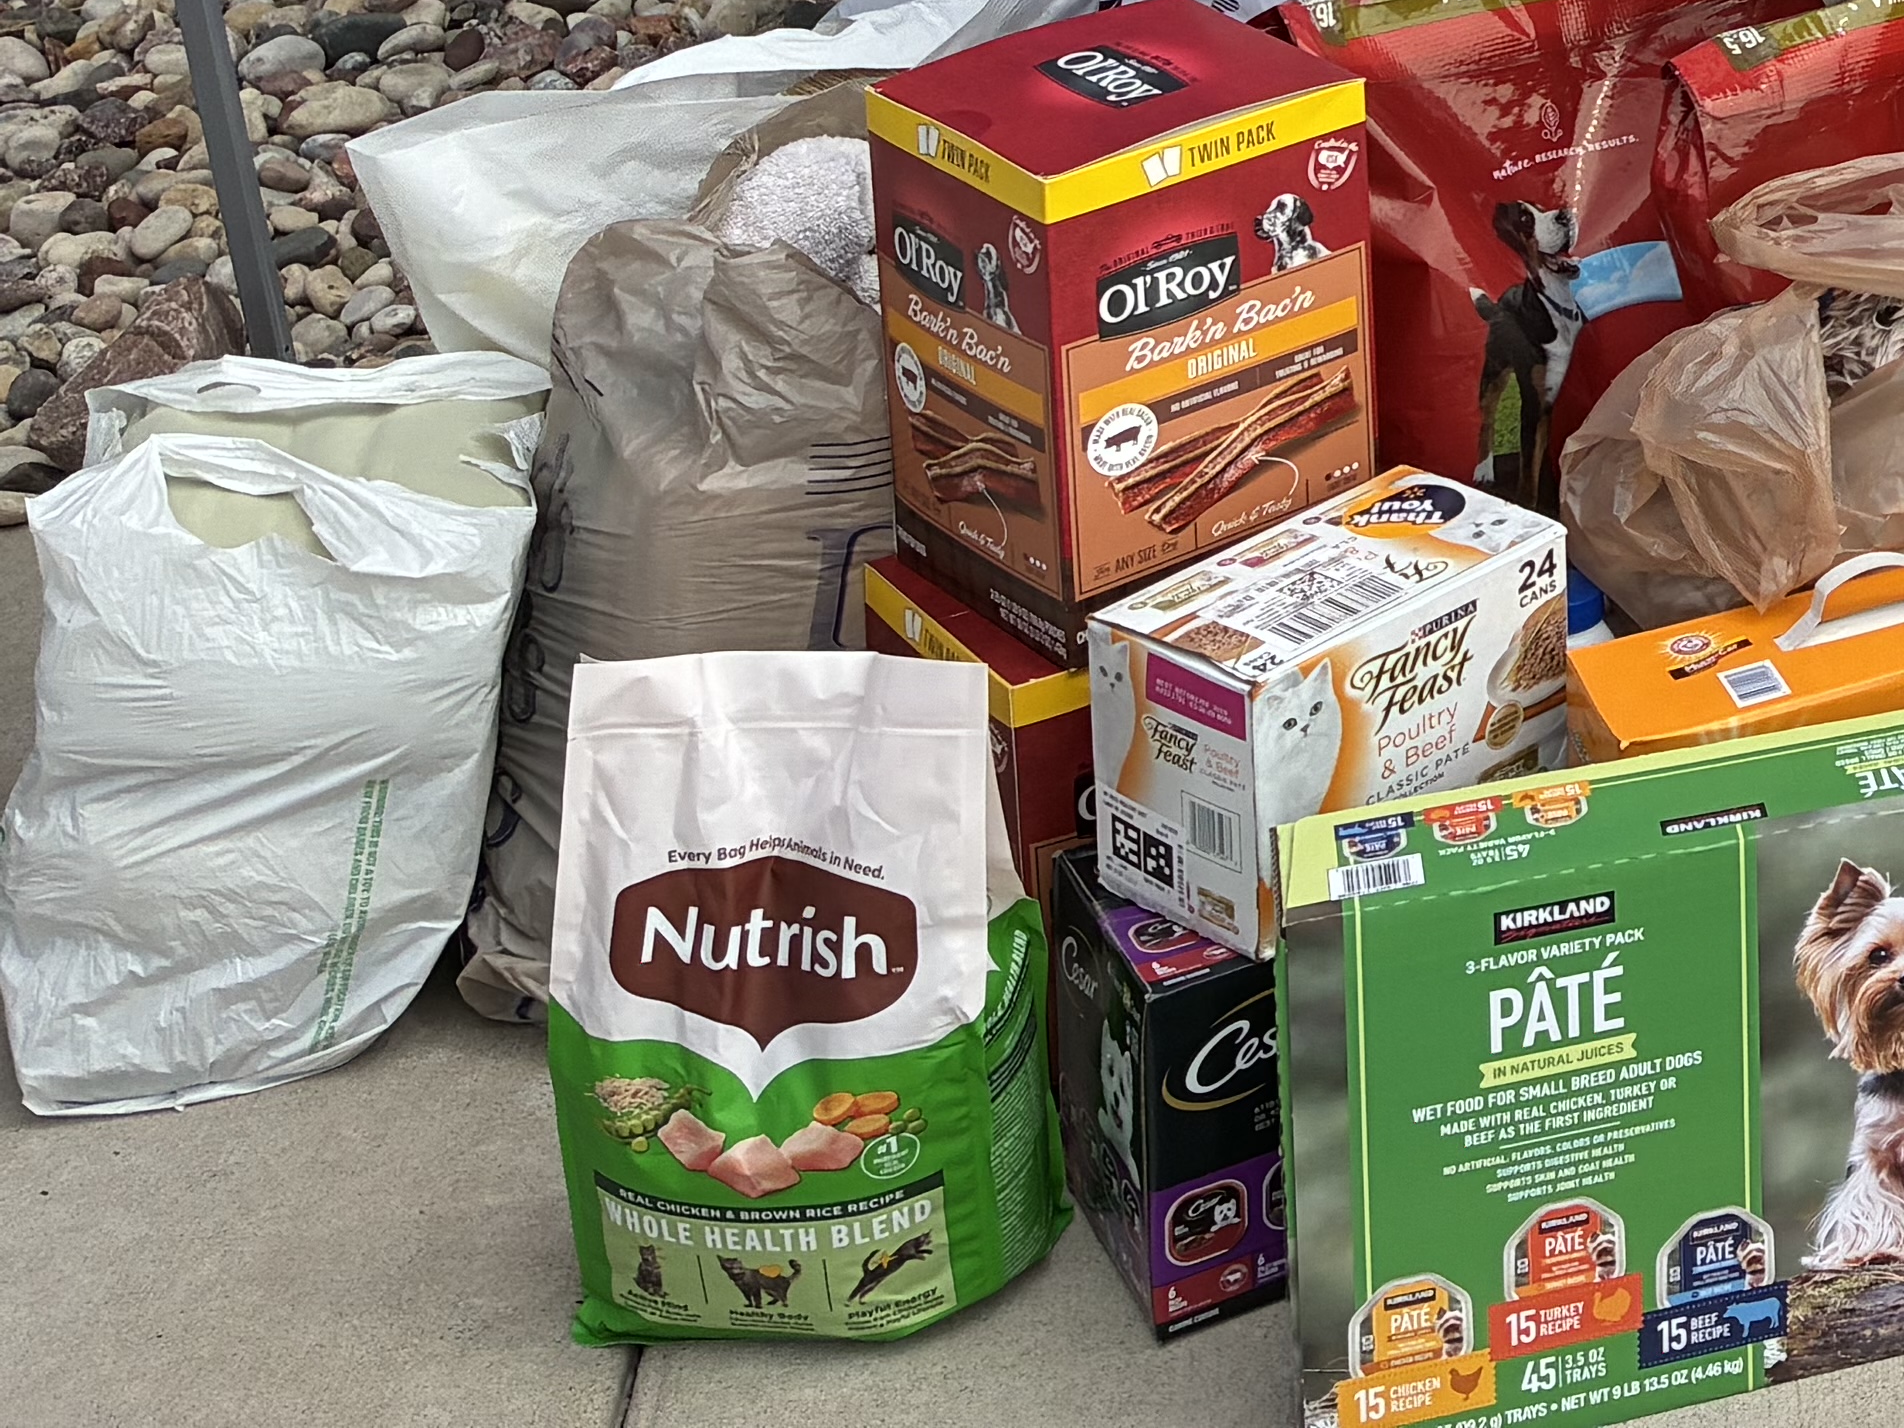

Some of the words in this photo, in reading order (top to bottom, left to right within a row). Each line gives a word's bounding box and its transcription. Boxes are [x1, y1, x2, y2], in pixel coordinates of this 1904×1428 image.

[1188, 134, 1230, 165] TWIN
[1236, 121, 1276, 152] PACK
[1099, 253, 1237, 325] Ol'Roy
[1187, 338, 1257, 379] ORIGINAL
[1518, 548, 1557, 594] 24
[1519, 580, 1557, 608] CANS
[1424, 602, 1475, 635] PURINA
[1350, 615, 1476, 703] Fancy
[1371, 650, 1474, 736] Feast
[1378, 702, 1458, 757] Poultry
[1381, 761, 1396, 780] &
[1405, 724, 1456, 769] Beef
[668, 850, 712, 864] Every
[718, 847, 746, 861] Bag
[829, 852, 841, 866] in
[843, 857, 885, 880] Need.
[1501, 896, 1611, 930] KIRKLAND
[640, 906, 888, 978] Nutrish
[1465, 949, 1536, 974] 3-FLAVOR
[1541, 937, 1602, 959] VARIETY
[1606, 929, 1644, 947] PACK
[1489, 952, 1624, 1054] PÂTÉ
[1492, 1066, 1507, 1079] IN
[1510, 1053, 1574, 1076] NATURAL
[1577, 1041, 1624, 1062] JUICES
[1413, 1103, 1444, 1123] WET
[1446, 1097, 1484, 1117] FOOD
[1488, 1091, 1516, 1109] FOR
[1520, 1081, 1567, 1104] SMALL
[1571, 1070, 1615, 1092] BREED
[1620, 1060, 1662, 1081] ADULT
[1666, 1051, 1703, 1072] DOGS
[1465, 1132, 1496, 1148] BEEF
[1499, 1127, 1515, 1141] AS
[1519, 1122, 1541, 1136] THE
[1545, 1114, 1580, 1131] FIRST
[1583, 1097, 1654, 1123] INGREDIENT
[605, 1198, 693, 1245] WHOLE
[704, 1225, 816, 1252] HEALTH
[831, 1199, 932, 1248] BLEND
[618, 1188, 652, 1208] REAL
[657, 1200, 721, 1220] CHICKEN
[739, 1209, 801, 1220] BROWN
[805, 1206, 842, 1219] RICE
[848, 1190, 905, 1214] RECIPE
[1506, 1309, 1537, 1347] 15
[1539, 1302, 1584, 1321] TURKEY
[1539, 1316, 1581, 1336] RECIPE
[1657, 1317, 1687, 1353] 15
[1690, 1313, 1718, 1329] BEEF
[1690, 1323, 1731, 1344] RECIPE
[1521, 1356, 1557, 1393] 45
[1564, 1353, 1585, 1368] 3.5
[1588, 1348, 1606, 1362] OZ
[1564, 1362, 1606, 1383] TRAYS
[1354, 1386, 1386, 1422] 15
[1390, 1377, 1441, 1399] CHICKEN
[1390, 1392, 1432, 1413] RECIPE
